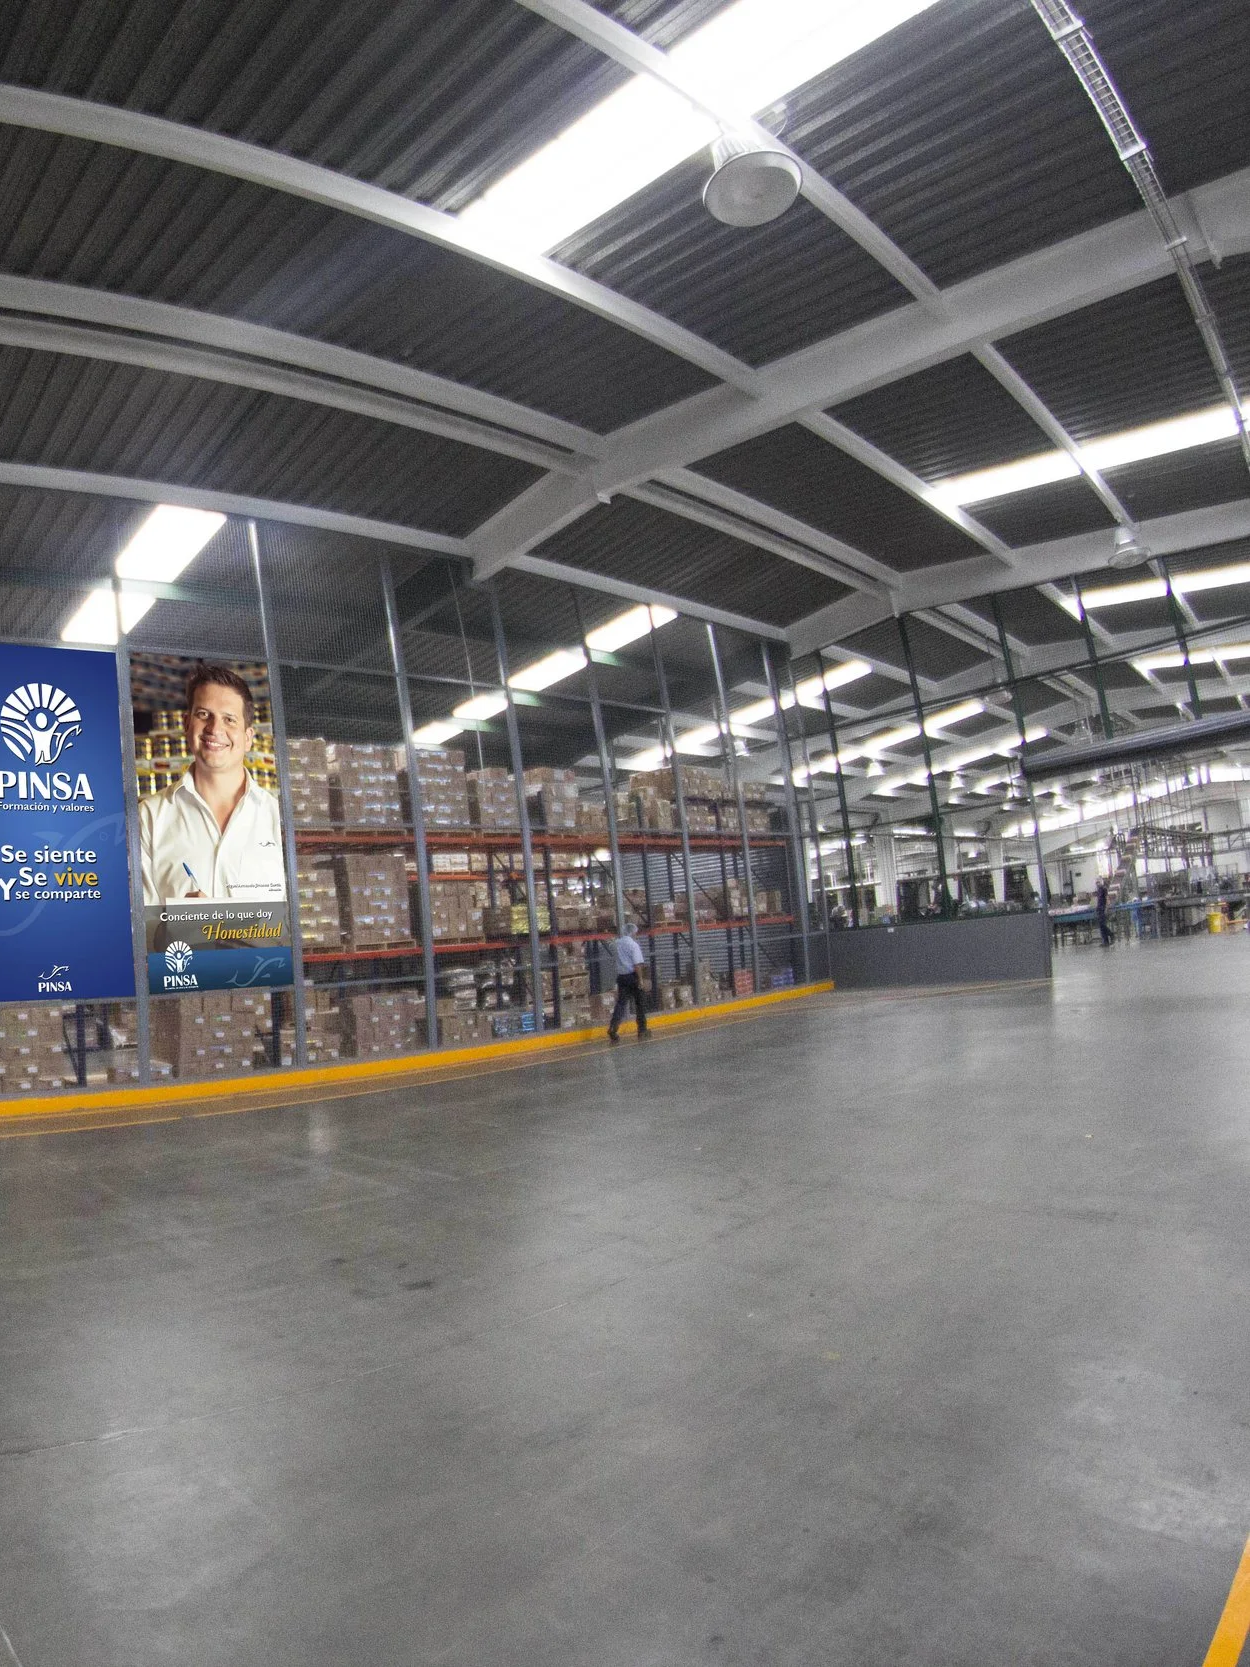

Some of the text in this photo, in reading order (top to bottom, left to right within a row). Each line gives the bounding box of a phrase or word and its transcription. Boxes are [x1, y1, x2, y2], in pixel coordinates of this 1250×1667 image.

[52, 804, 58, 814] y
[60, 803, 94, 812] valores
[0, 844, 97, 863] Se siente
[19, 866, 98, 886] Se vive
[15, 890, 30, 900] se
[34, 889, 101, 902] comparte
[160, 909, 273, 922] Conciente de lo que doy
[202, 920, 283, 940] Honestidad
[38, 981, 73, 992] PINSA
[163, 974, 198, 988] PINSA
